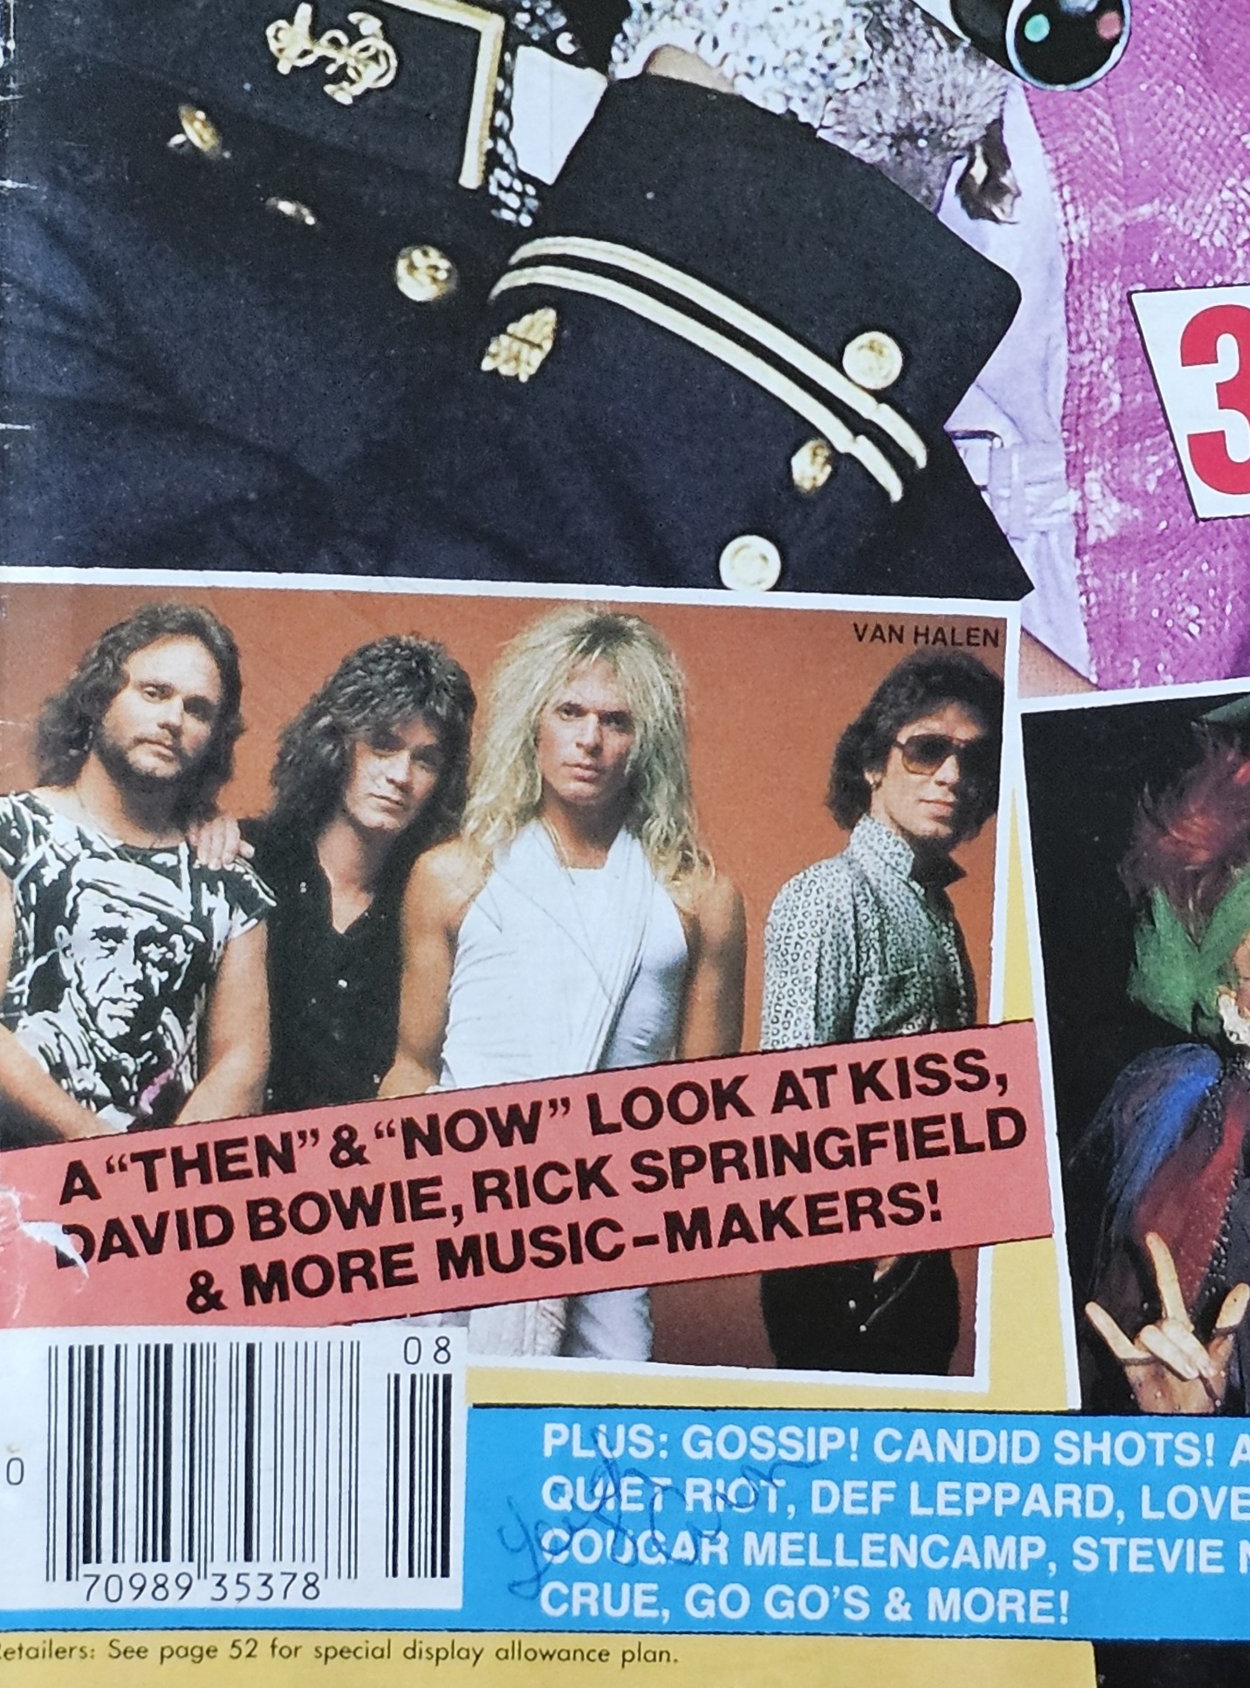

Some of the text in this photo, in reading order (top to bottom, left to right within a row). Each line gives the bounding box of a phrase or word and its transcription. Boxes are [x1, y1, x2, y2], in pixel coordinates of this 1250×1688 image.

[853, 622, 999, 648] VAN HALEN
[59, 1160, 102, 1206] A
[329, 1123, 370, 1169] &
[587, 1074, 755, 1137] LOOK
[771, 1064, 837, 1116] AT
[848, 1048, 1009, 1107] KISS,
[56, 1106, 1026, 1270] DAVID BOWIE, RICK SPRINGFIELD
[186, 1179, 942, 1315] & MORE MUSIC-MAKERS!
[543, 1422, 669, 1460] PLUS:
[682, 1423, 859, 1463] GOSSIP!
[873, 1427, 1040, 1466] CANDID
[1053, 1429, 1215, 1469] SHOTS!
[542, 1477, 670, 1513] QUIET
[685, 1478, 797, 1518] RIOT,
[812, 1479, 897, 1516] DEF
[909, 1480, 1126, 1526] LEPPARD,
[540, 1529, 729, 1566] COUGAR
[743, 1530, 1057, 1577] MELLENCAMP,
[1072, 1537, 1225, 1575] STEVIE
[82, 1571, 321, 1604] 70989 35378
[539, 1581, 1069, 1625] CRUE, GO GO'S & MORE!
[108, 1638, 148, 1660] See
[160, 1642, 218, 1665] page
[229, 1638, 258, 1660] 52
[270, 1637, 303, 1659] for
[314, 1638, 391, 1665] special
[402, 1638, 484, 1667] display
[495, 1639, 610, 1663] allowance
[621, 1641, 678, 1669] plan.
